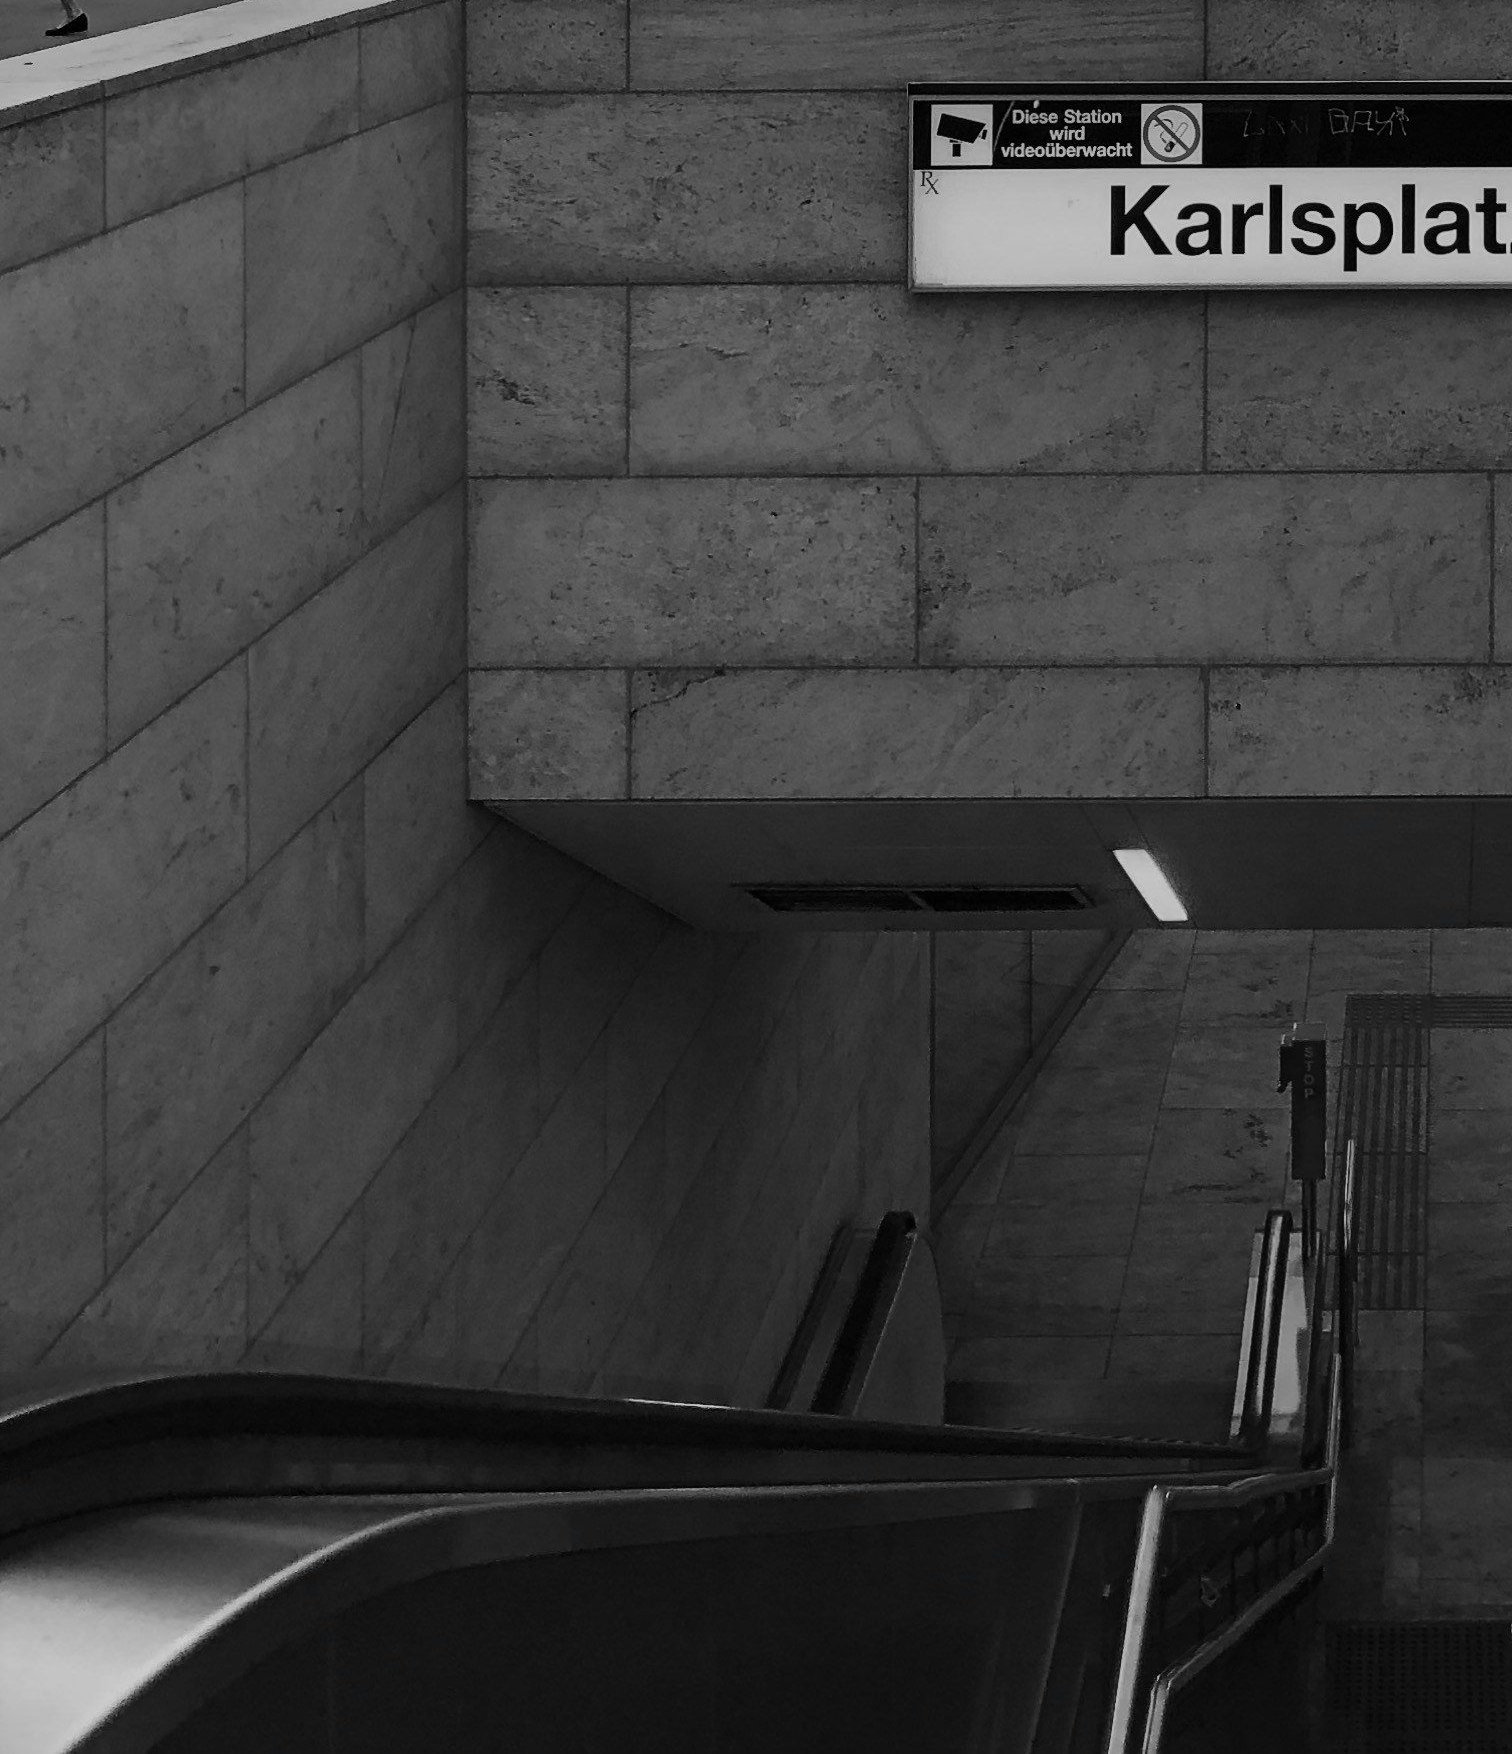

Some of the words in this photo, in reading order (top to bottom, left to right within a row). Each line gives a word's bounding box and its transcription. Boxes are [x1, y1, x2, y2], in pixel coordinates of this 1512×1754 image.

[1012, 109, 1059, 124] Diese
[1063, 109, 1122, 124] Station
[1049, 126, 1086, 141] wird
[1001, 142, 1133, 158] videoüberwacht
[1303, 1046, 1316, 1099] STOP
